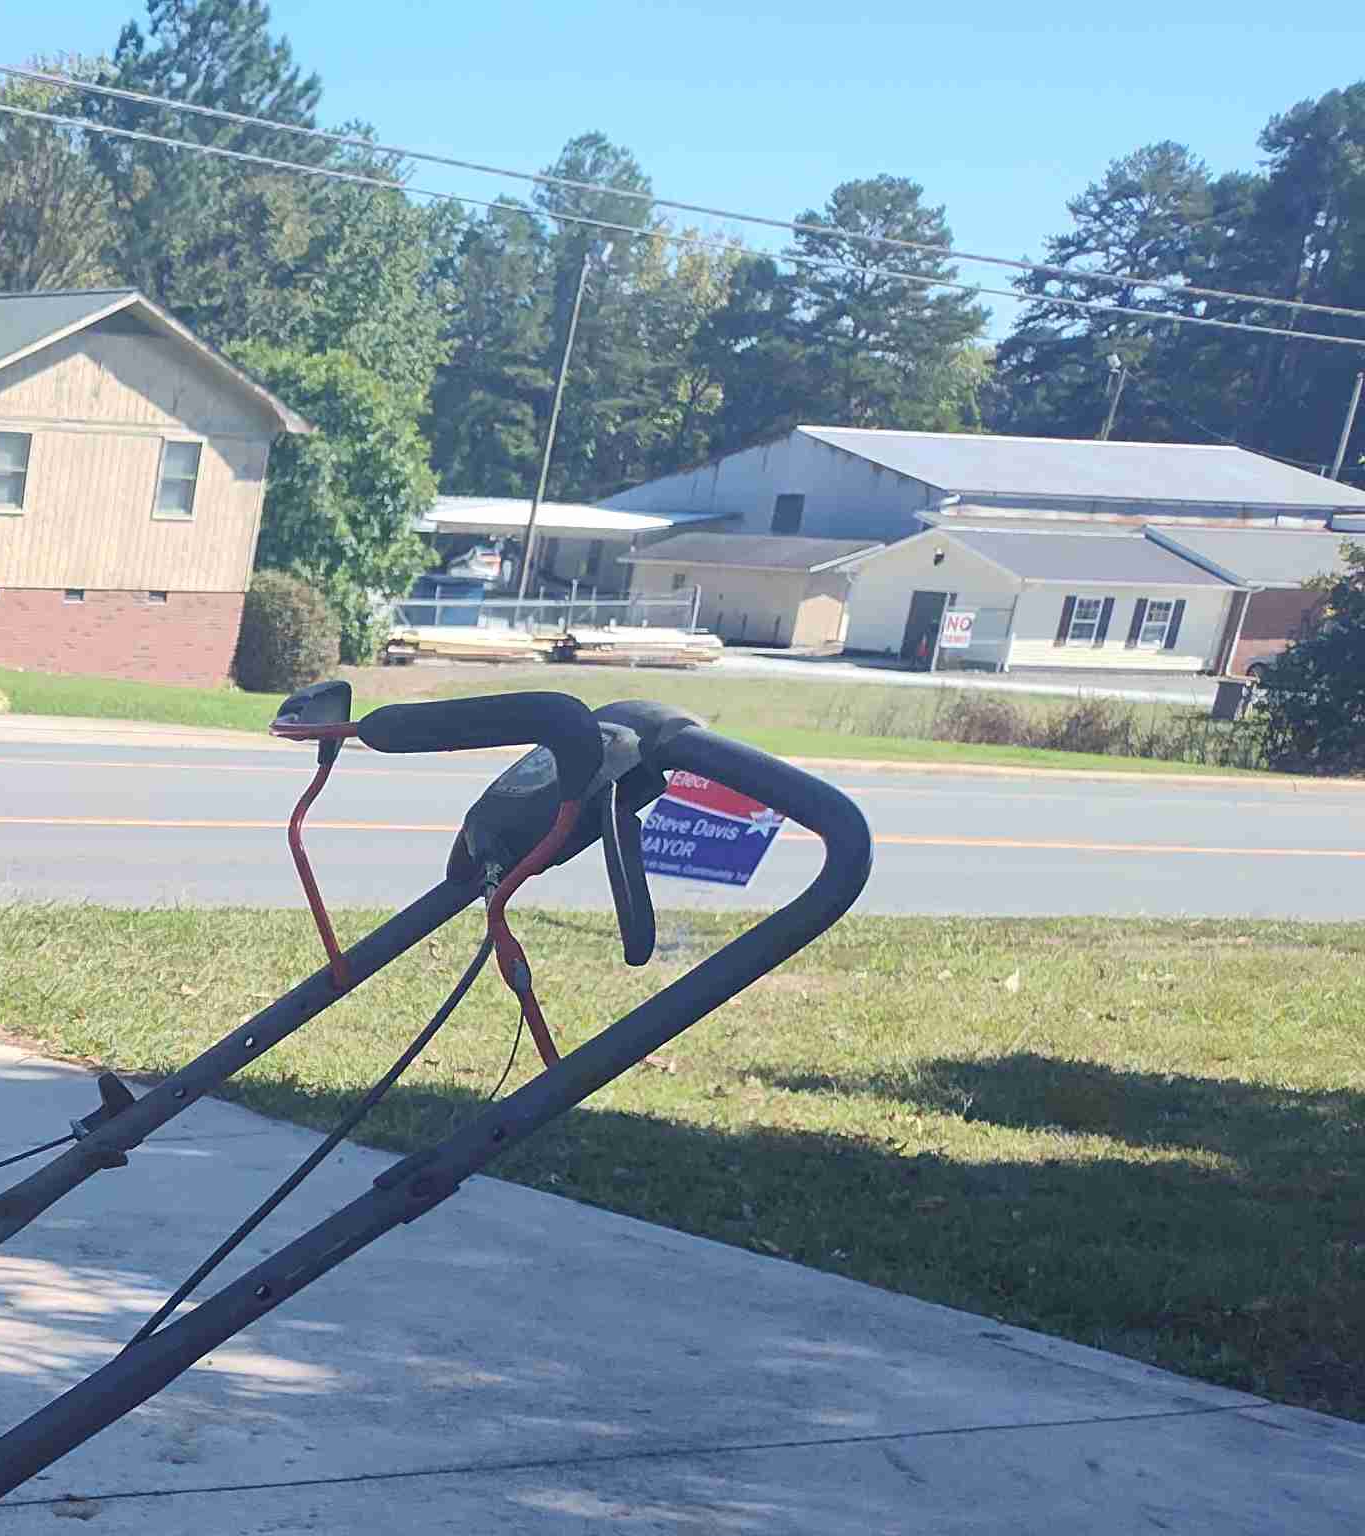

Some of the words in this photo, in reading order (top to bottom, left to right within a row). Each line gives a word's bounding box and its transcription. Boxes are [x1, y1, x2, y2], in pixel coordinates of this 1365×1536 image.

[946, 616, 973, 633] NO
[671, 771, 710, 790] Elect
[644, 812, 691, 834] Steve
[693, 818, 739, 841] Davis
